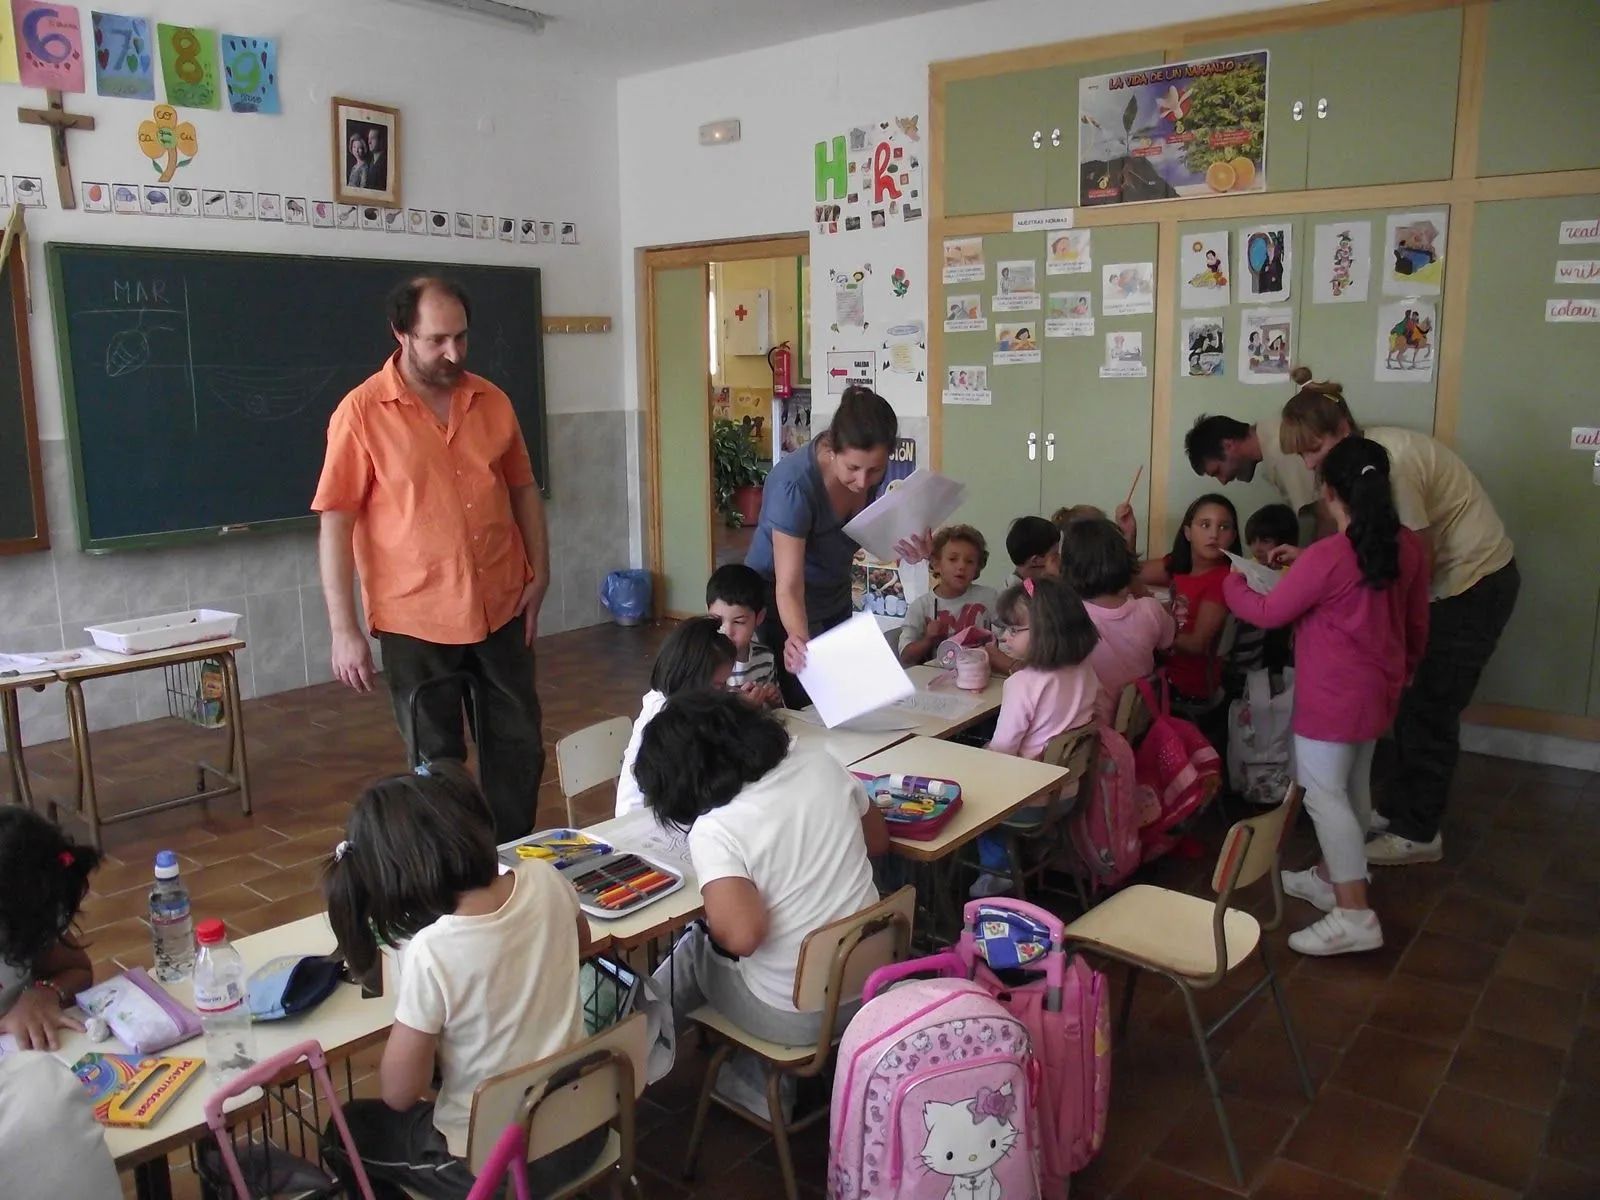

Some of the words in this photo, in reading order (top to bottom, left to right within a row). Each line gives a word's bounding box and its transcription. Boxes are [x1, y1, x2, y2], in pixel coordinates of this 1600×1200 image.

[22, 8, 72, 63] 6
[111, 28, 133, 70] 7
[171, 29, 204, 84] 8
[232, 51, 262, 93] 9
[1108, 77, 1125, 91] LA
[1124, 74, 1150, 88] VIDA
[1149, 71, 1164, 83] DE
[1165, 68, 1183, 81] UN
[814, 135, 848, 202] H
[114, 279, 170, 304] MAR
